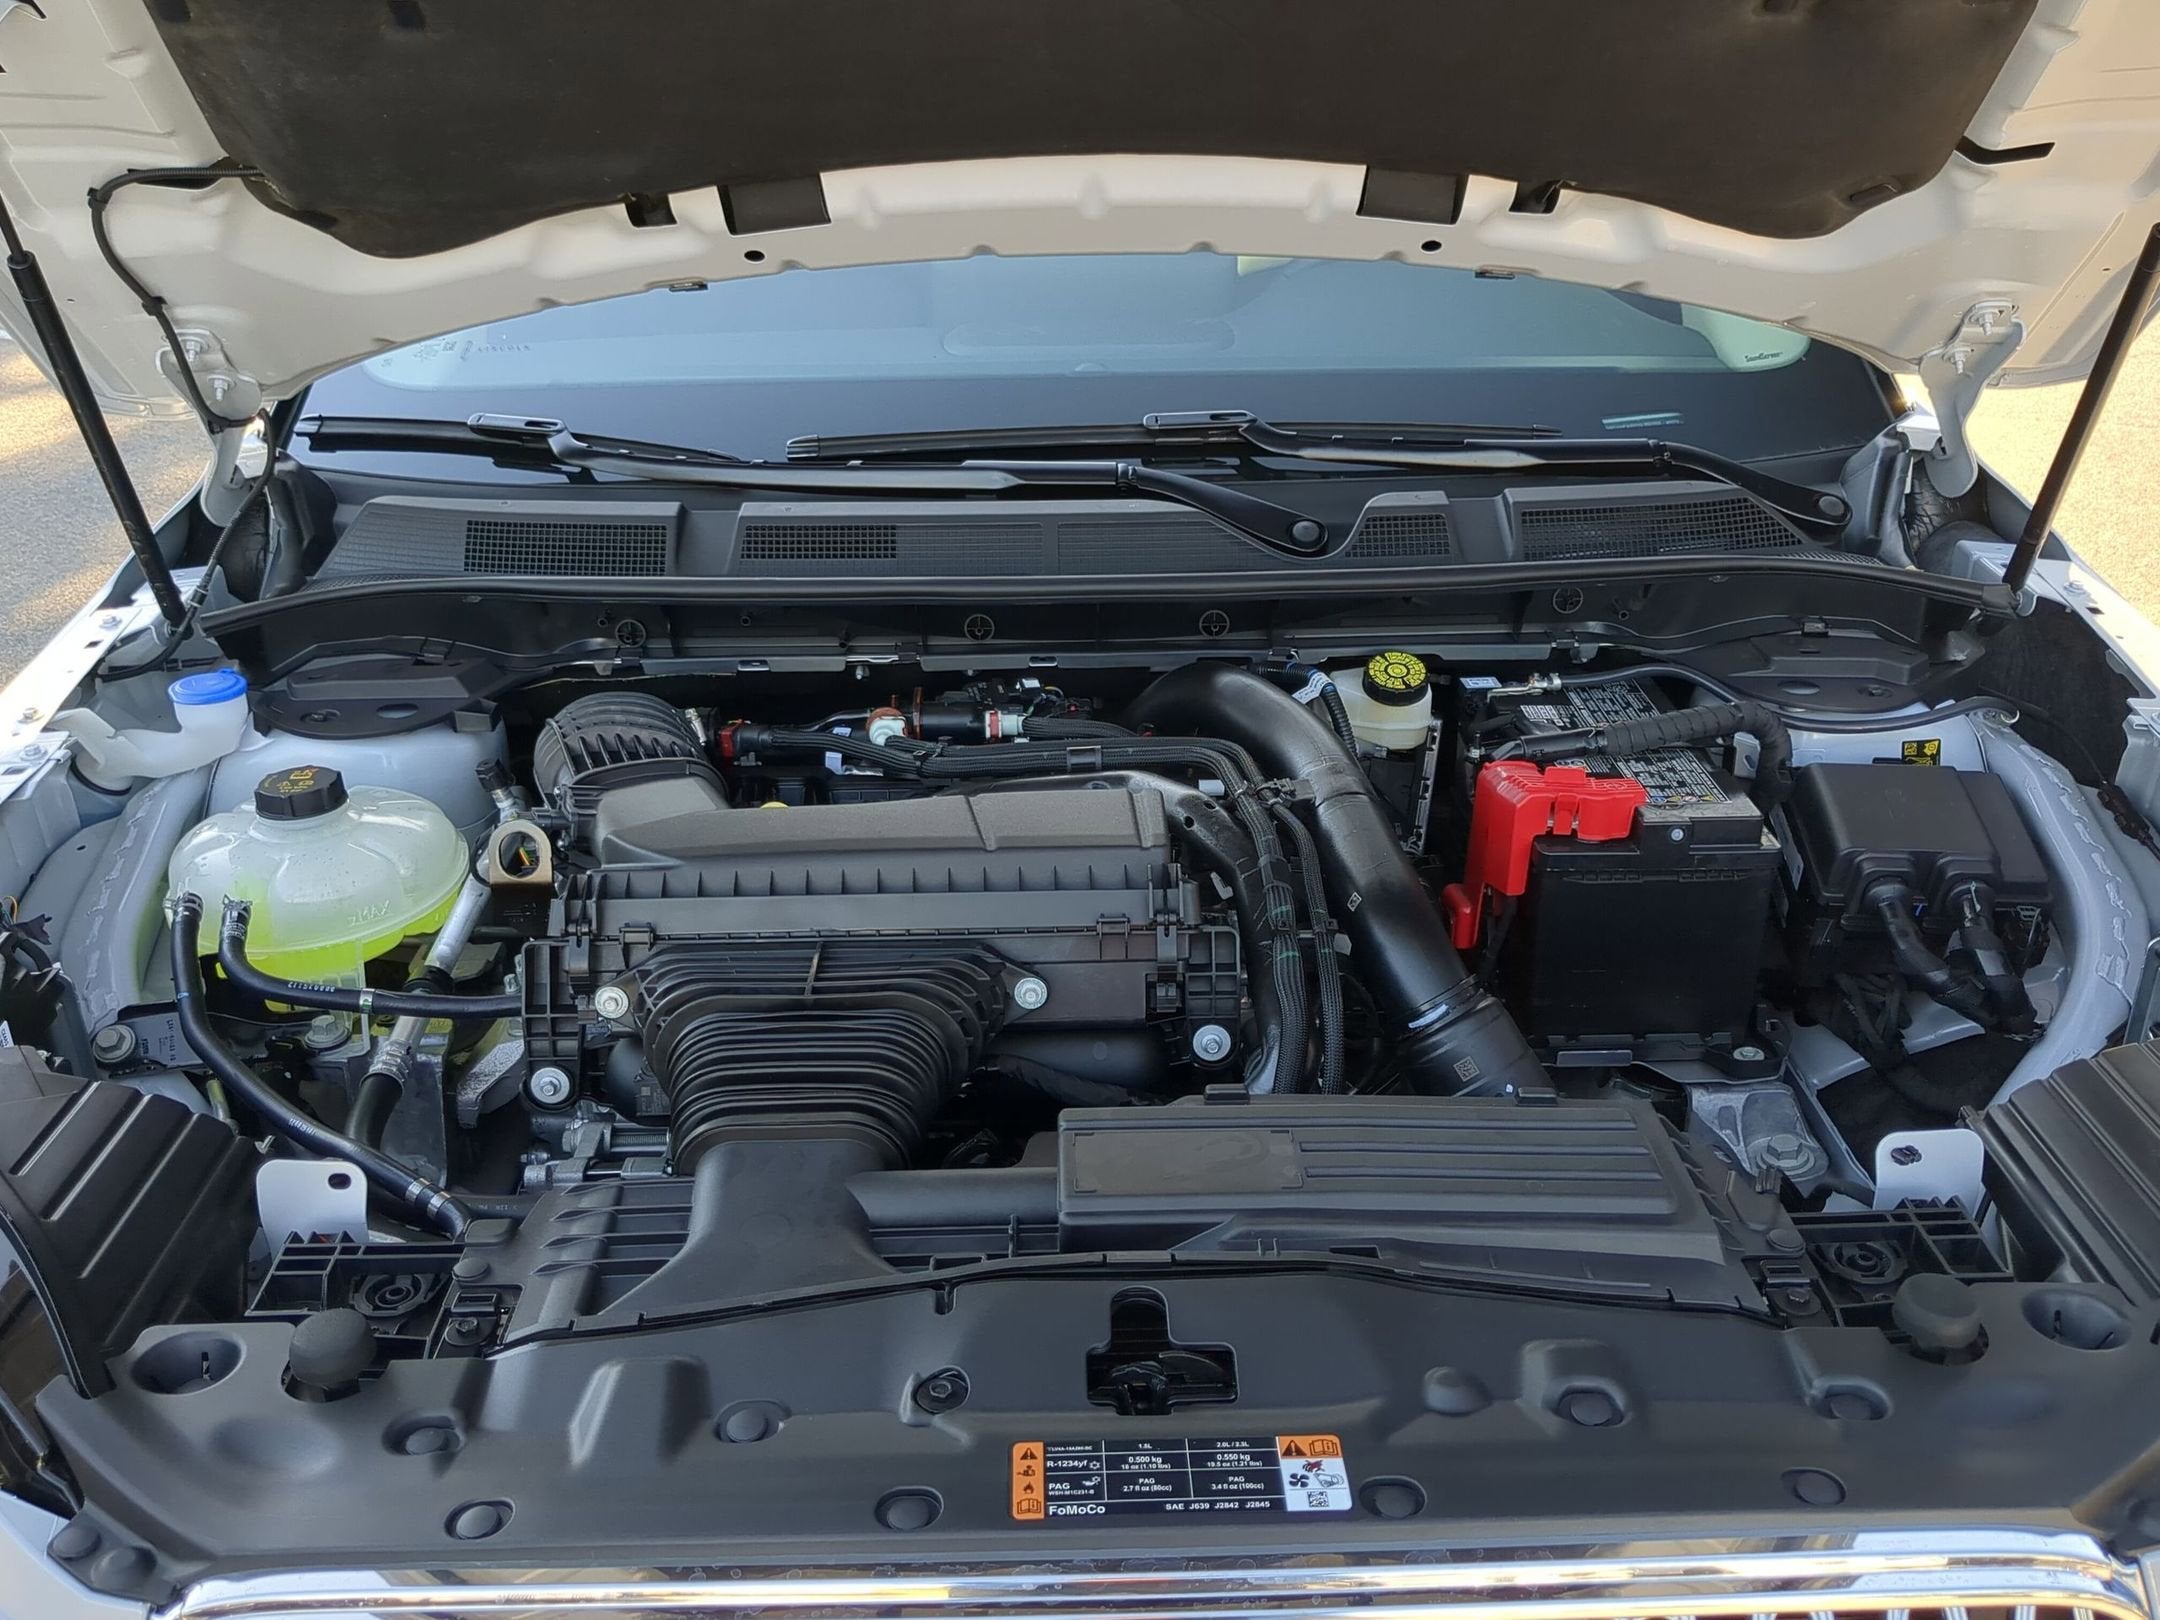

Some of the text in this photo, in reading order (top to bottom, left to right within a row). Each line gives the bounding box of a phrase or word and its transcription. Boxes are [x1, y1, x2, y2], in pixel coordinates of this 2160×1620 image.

[1151, 1455, 1162, 1464] kg
[1216, 1452, 1251, 1462] 0.550 kg
[1046, 1459, 1088, 1468] R-1234yf
[1048, 1482, 1070, 1490] PAG
[1049, 1504, 1106, 1516] FoMoCo
[1165, 1500, 1270, 1511] SAE J639 J2842 J2845
